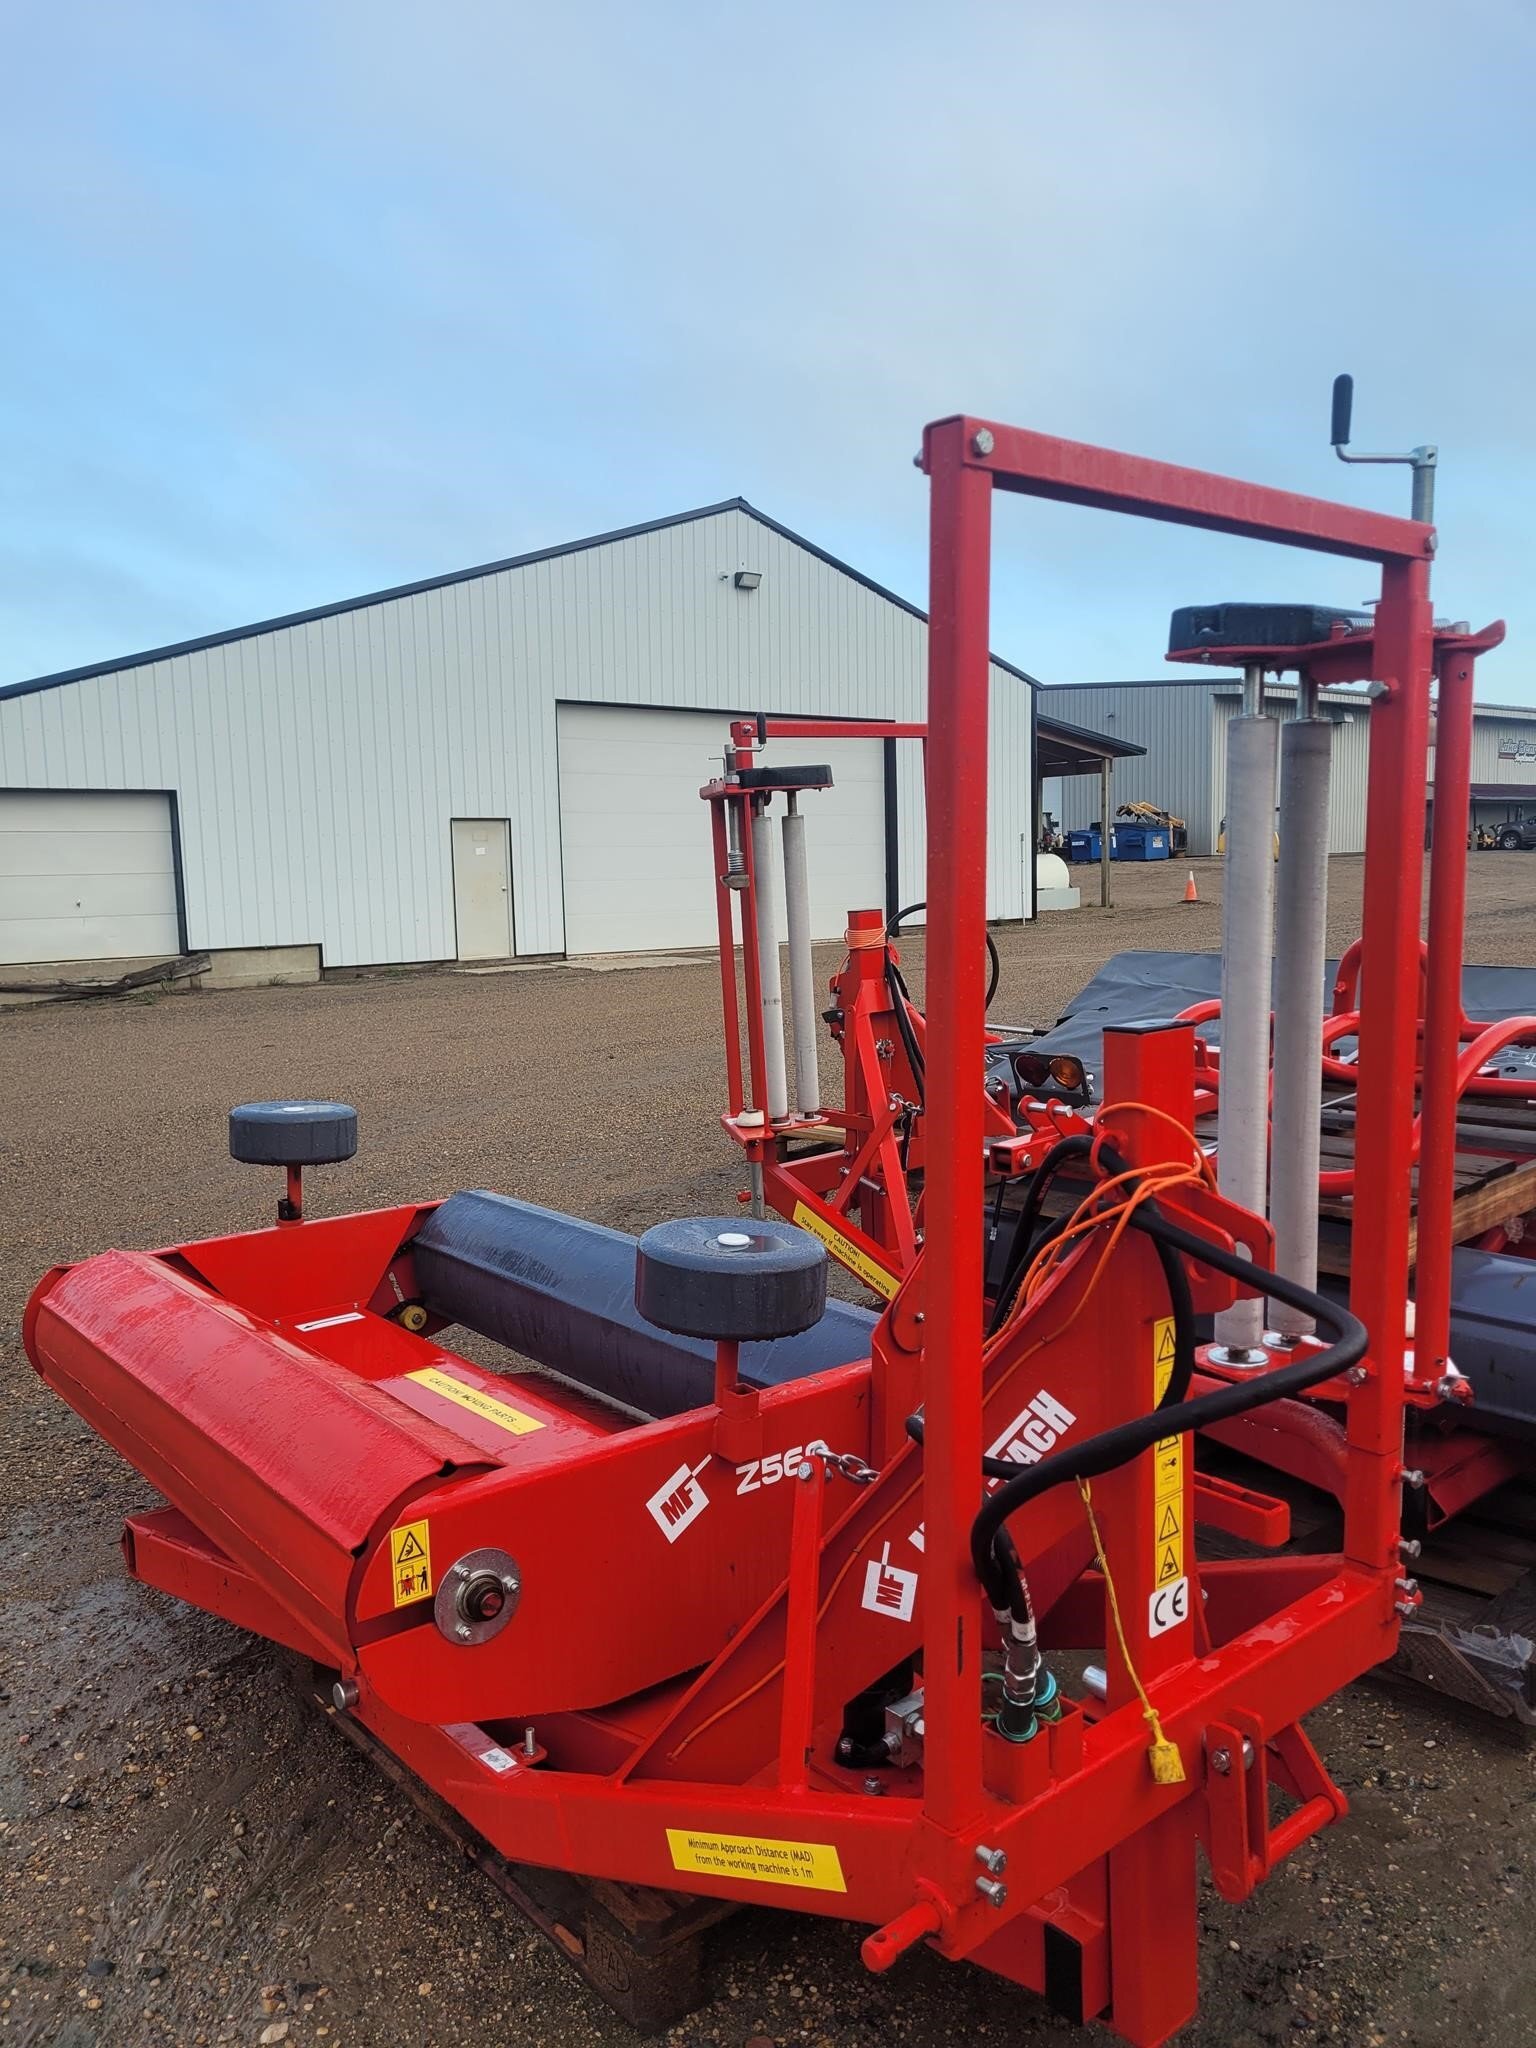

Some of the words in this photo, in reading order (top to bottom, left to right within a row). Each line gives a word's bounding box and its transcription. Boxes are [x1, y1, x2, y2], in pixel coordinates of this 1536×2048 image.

[801, 1216, 812, 1230] Stay
[833, 1244, 856, 1266] machine
[862, 1269, 890, 1296] operating
[490, 1408, 517, 1422] PARTS
[688, 1838, 720, 1852] Minimum
[720, 1842, 754, 1856] Approach
[756, 1845, 788, 1860] Distance
[790, 1850, 814, 1865] (MAD)
[695, 1853, 712, 1865] from
[713, 1855, 726, 1867] the
[726, 1859, 756, 1873] working
[758, 1862, 790, 1876] machine
[792, 1867, 799, 1877] is
[800, 1867, 814, 1879] 1m
